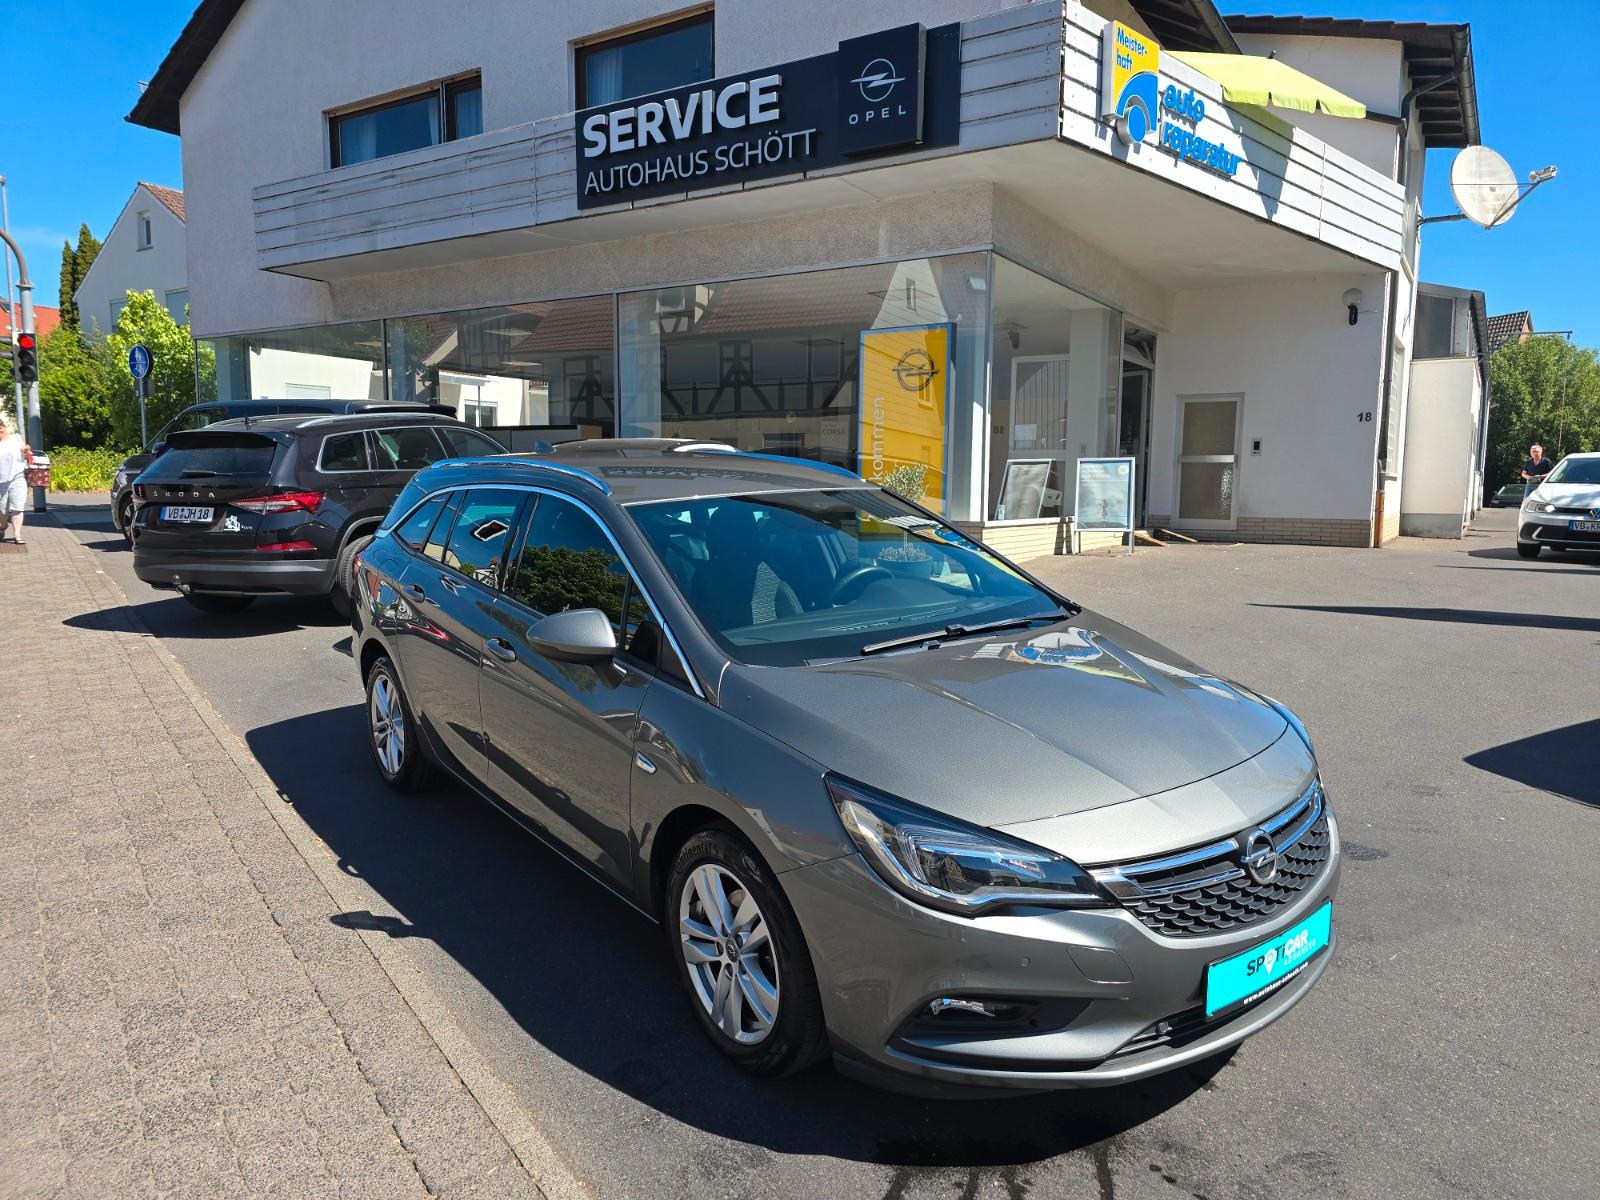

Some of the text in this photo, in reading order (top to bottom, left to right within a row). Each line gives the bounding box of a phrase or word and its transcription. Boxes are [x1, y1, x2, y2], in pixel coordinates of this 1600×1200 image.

[1117, 27, 1148, 56] Meister-
[1116, 47, 1133, 72] haft
[582, 73, 783, 158] SERVICE
[848, 105, 907, 125] OPEL
[1163, 84, 1206, 122] auto
[584, 128, 817, 195] AUTOHAUS SCHÖTT
[1163, 122, 1243, 175] reparatur
[1356, 412, 1372, 422] 18
[197, 509, 210, 519] 18
